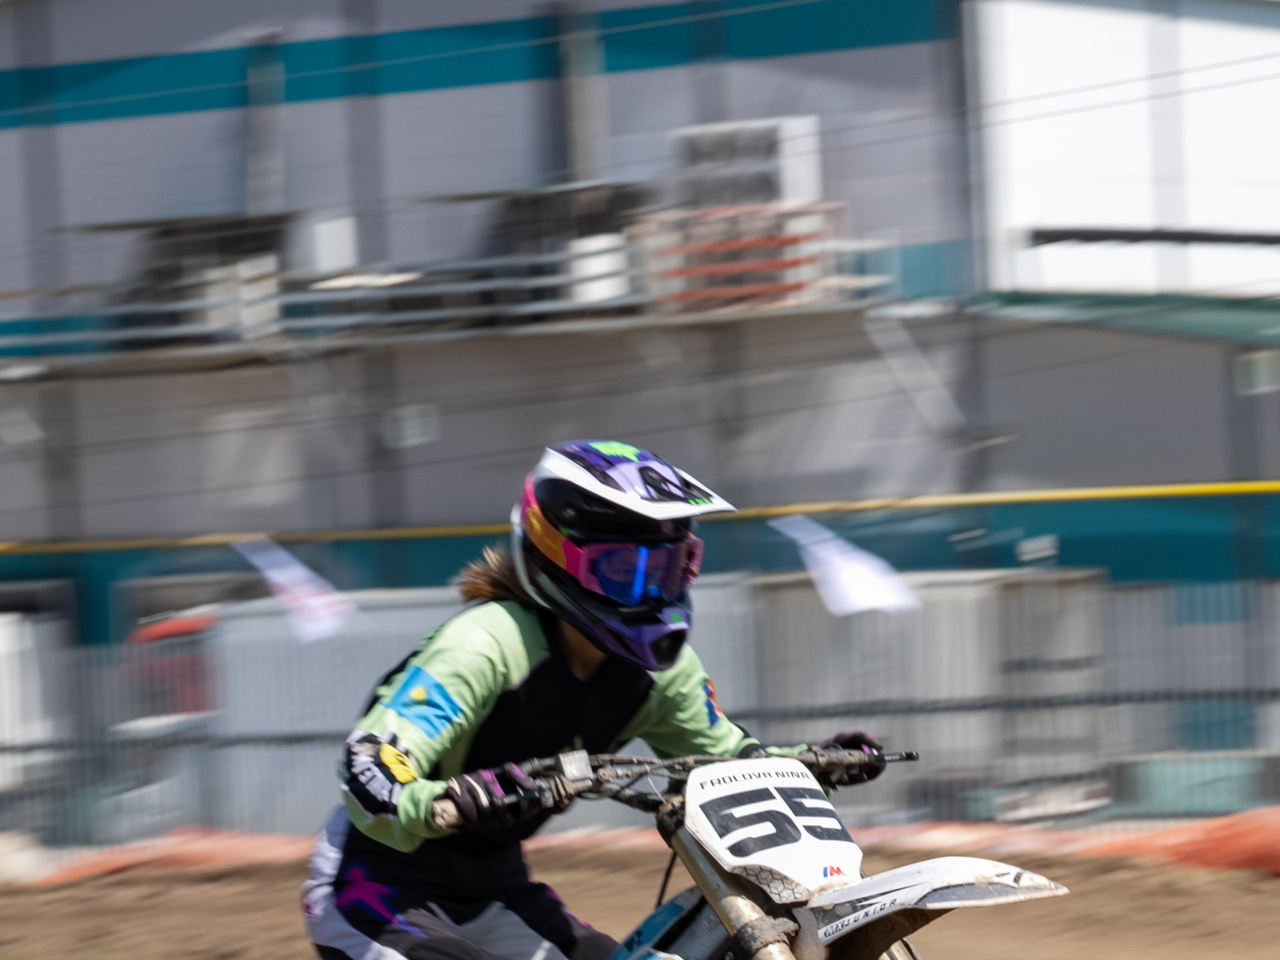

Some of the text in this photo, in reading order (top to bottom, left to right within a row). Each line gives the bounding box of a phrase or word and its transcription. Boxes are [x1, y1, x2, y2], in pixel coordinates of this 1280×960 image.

[699, 771, 810, 790] FROLOVA NINA
[699, 786, 858, 858] 55
